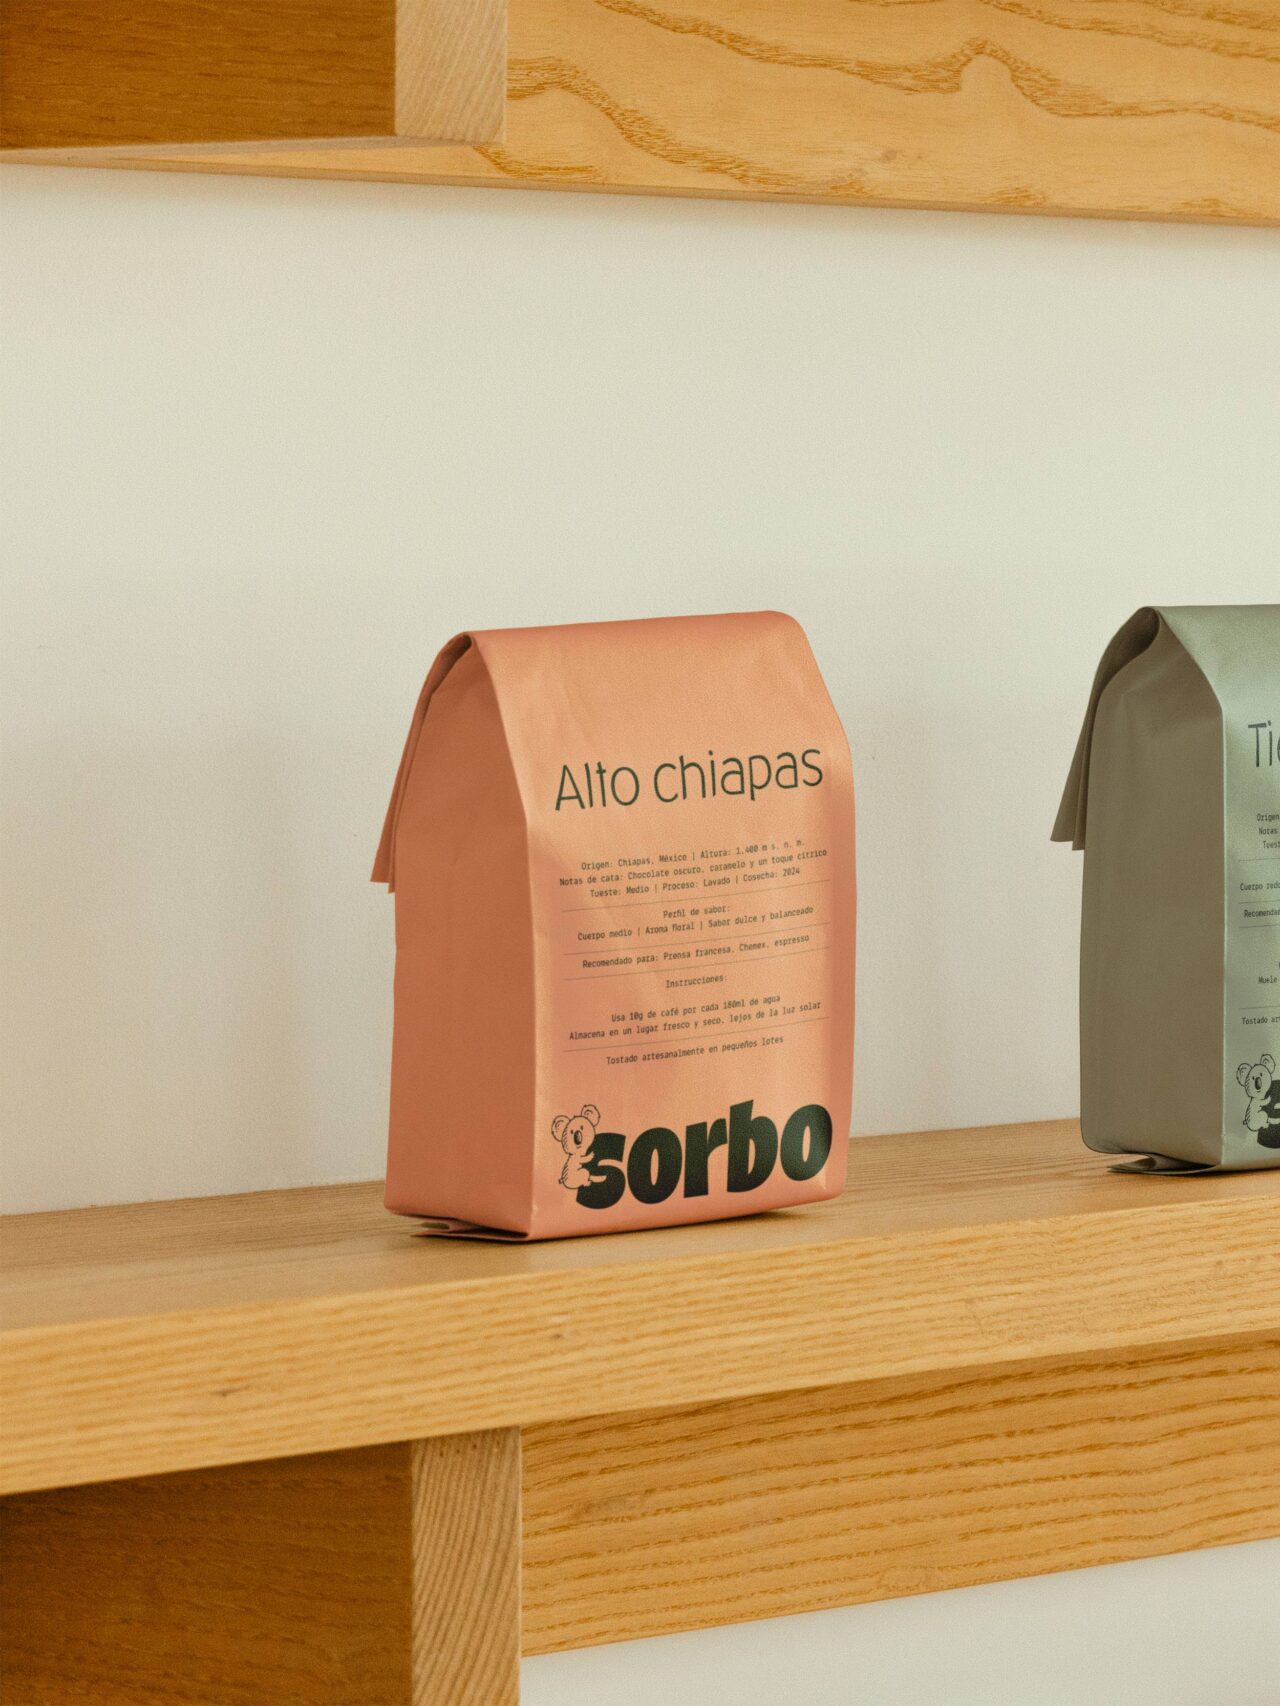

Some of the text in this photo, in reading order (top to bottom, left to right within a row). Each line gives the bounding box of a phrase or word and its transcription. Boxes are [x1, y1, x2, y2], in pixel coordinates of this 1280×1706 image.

[555, 748, 823, 811] Alto chiapas
[559, 877, 582, 885] Notas
[587, 875, 596, 883] de
[601, 873, 622, 882] cata:
[628, 869, 669, 880] Chocolate
[709, 859, 745, 871] caramelo
[749, 860, 753, 869] y
[771, 854, 793, 864] toque
[798, 848, 828, 860] cítrico
[581, 860, 612, 871] Origen:
[659, 853, 686, 863] México
[590, 866, 800, 897] Tueste: Medio Proceso: Lavado Cosecha: 2024
[578, 905, 813, 941] Cuerpo medio Aroma floral Sabor dulce y balanceado
[663, 904, 729, 919] Perfil de sabor:
[582, 956, 632, 968] Recomendado
[636, 955, 658, 965] para:
[663, 951, 690, 960] Prensa
[774, 935, 809, 947] espresso
[665, 975, 726, 987] Instrucciones:
[569, 1031, 604, 1040] Almacena
[636, 1025, 658, 1035] lugar
[663, 1021, 689, 1031] fresco
[694, 1020, 698, 1029] y
[729, 1012, 751, 1023] lejos
[756, 1010, 764, 1019] de
[769, 1008, 777, 1017] la
[782, 1006, 795, 1014] luz
[799, 1001, 821, 1012] solar
[611, 1013, 625, 1022] Usa
[647, 1010, 656, 1018] de
[661, 1007, 678, 1017] café
[683, 1007, 696, 1016] por
[701, 1002, 718, 1012] cada
[749, 997, 758, 1006] de
[763, 995, 780, 1005] agua
[606, 1054, 637, 1064] Tostado
[642, 1047, 704, 1061] artesanalmente
[722, 1039, 757, 1053] pequeños
[761, 1036, 783, 1046] lotes
[576, 1099, 833, 1209] sorbo
